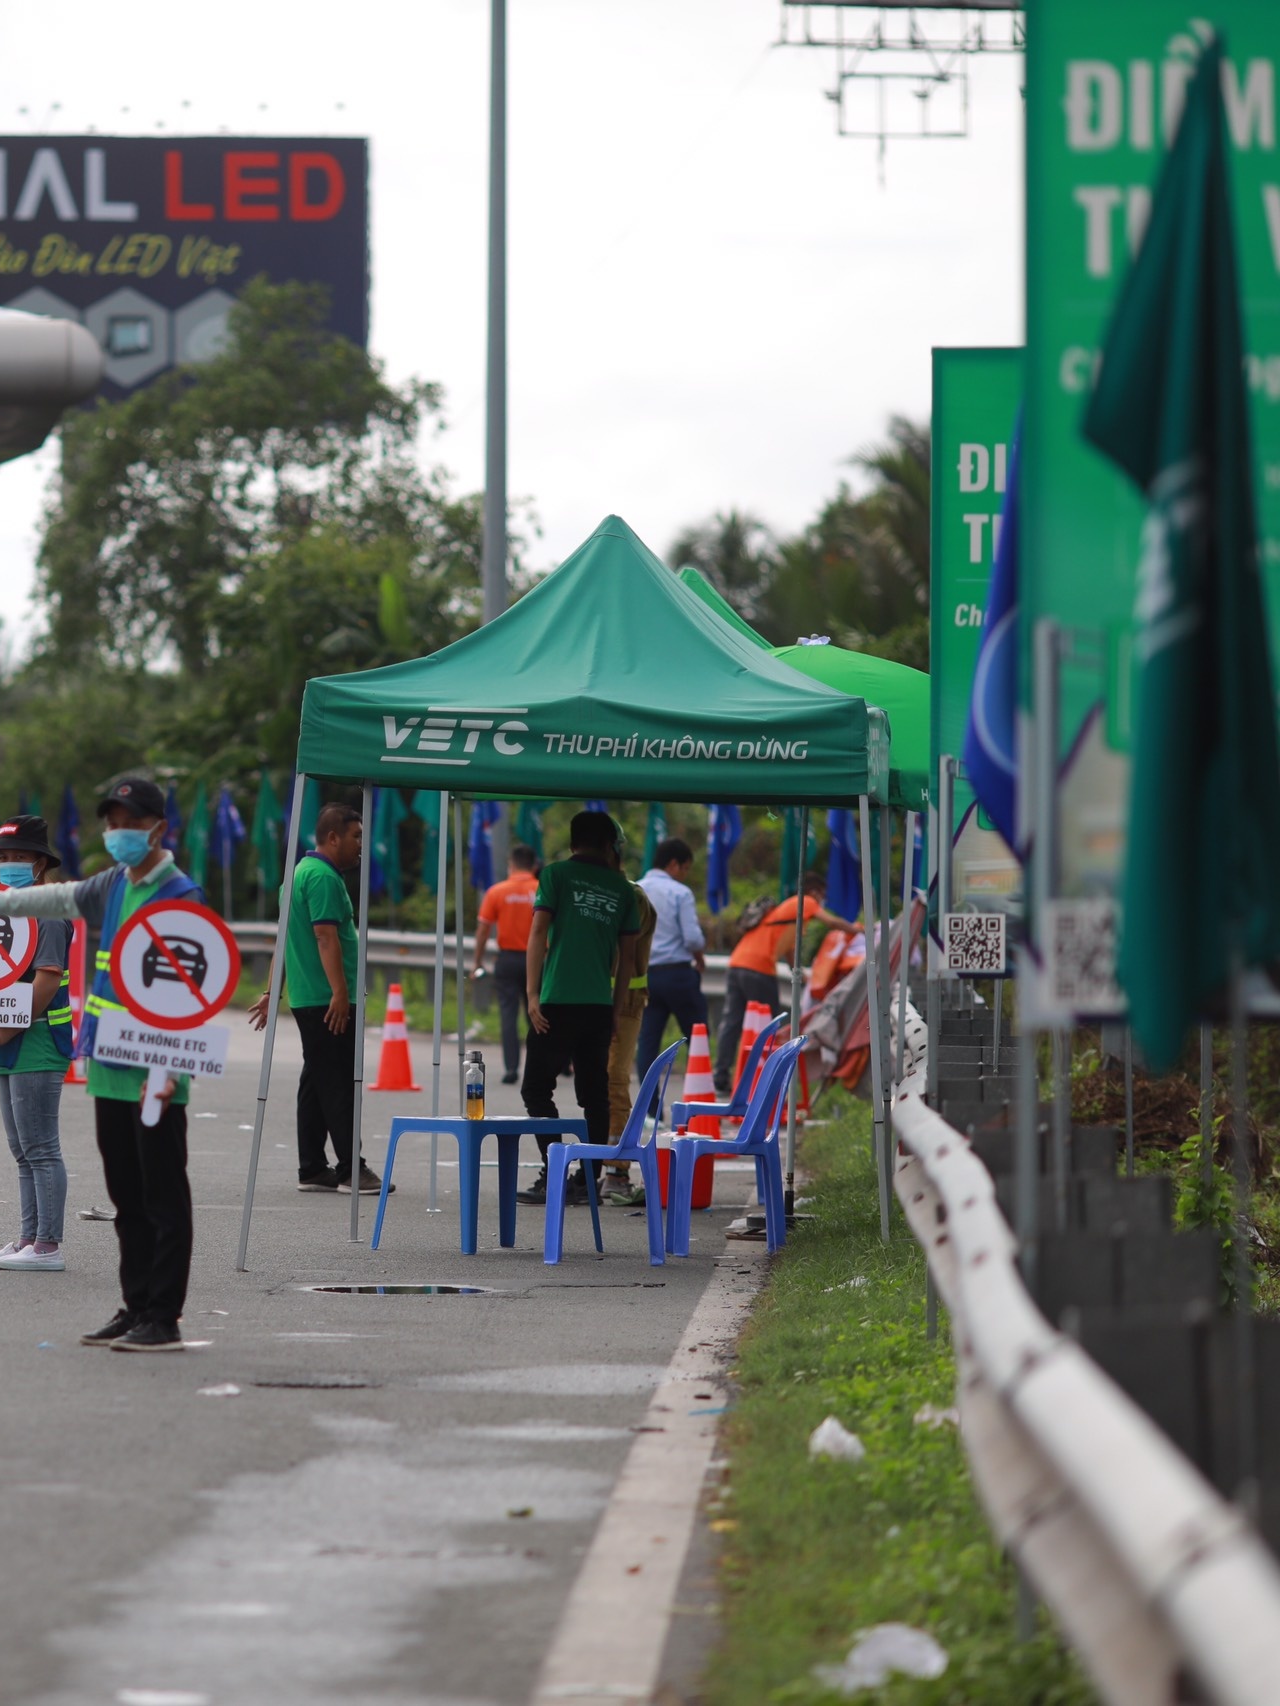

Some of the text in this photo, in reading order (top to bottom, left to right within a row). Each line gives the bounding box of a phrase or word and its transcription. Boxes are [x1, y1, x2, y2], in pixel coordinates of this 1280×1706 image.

[165, 151, 346, 222] LED
[95, 234, 171, 276] LED
[956, 442, 1007, 493] ĐI
[381, 711, 809, 760] VETC THU PHÍ KHÔNG DỪNG
[573, 891, 618, 912] VETC
[0, 998, 17, 1008] ETC
[12, 1011, 29, 1024] TỐC
[119, 1029, 207, 1053] XE KHÔNG ETC
[97, 1044, 223, 1075] KHÔNG VÀO CAO TỐC
